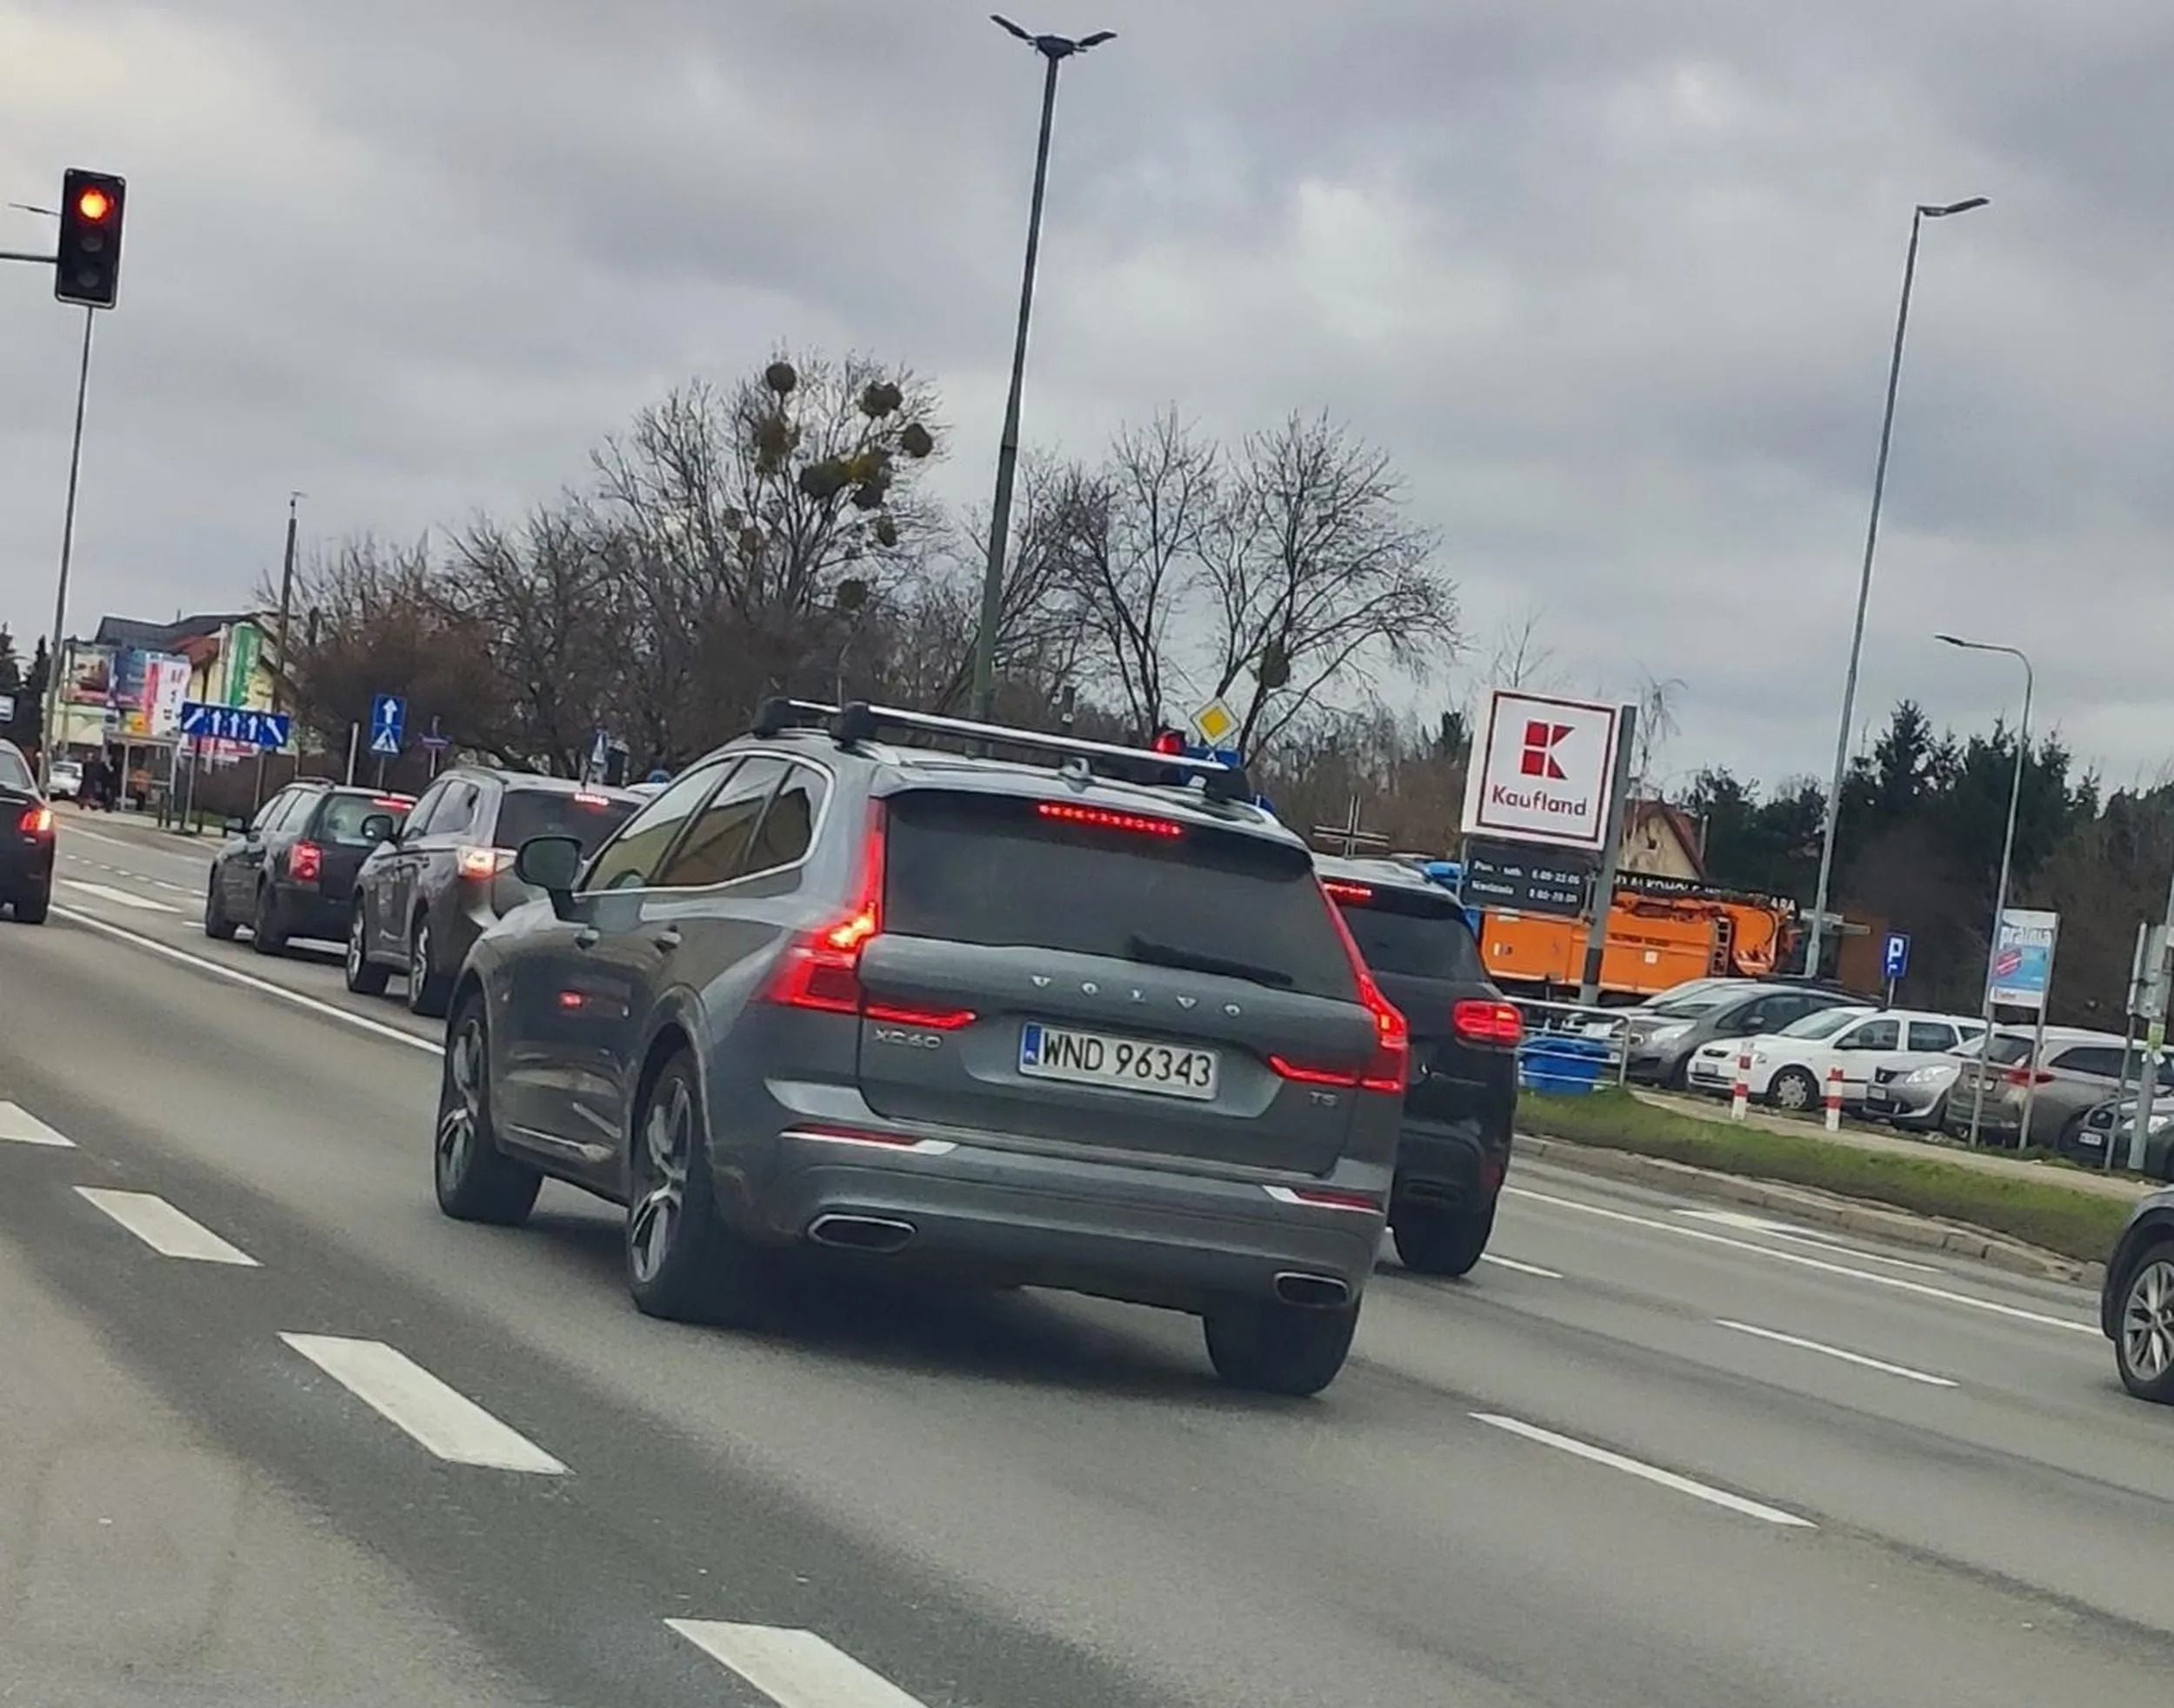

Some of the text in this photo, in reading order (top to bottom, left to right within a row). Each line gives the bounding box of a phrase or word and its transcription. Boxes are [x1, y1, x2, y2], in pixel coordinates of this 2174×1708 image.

[1492, 784, 1587, 816] Kaufland
[1888, 937, 1904, 963] P
[1031, 974, 1240, 1017] VOLVO
[874, 1027, 943, 1049] XC60
[1044, 1031, 1212, 1087] WND 96343
